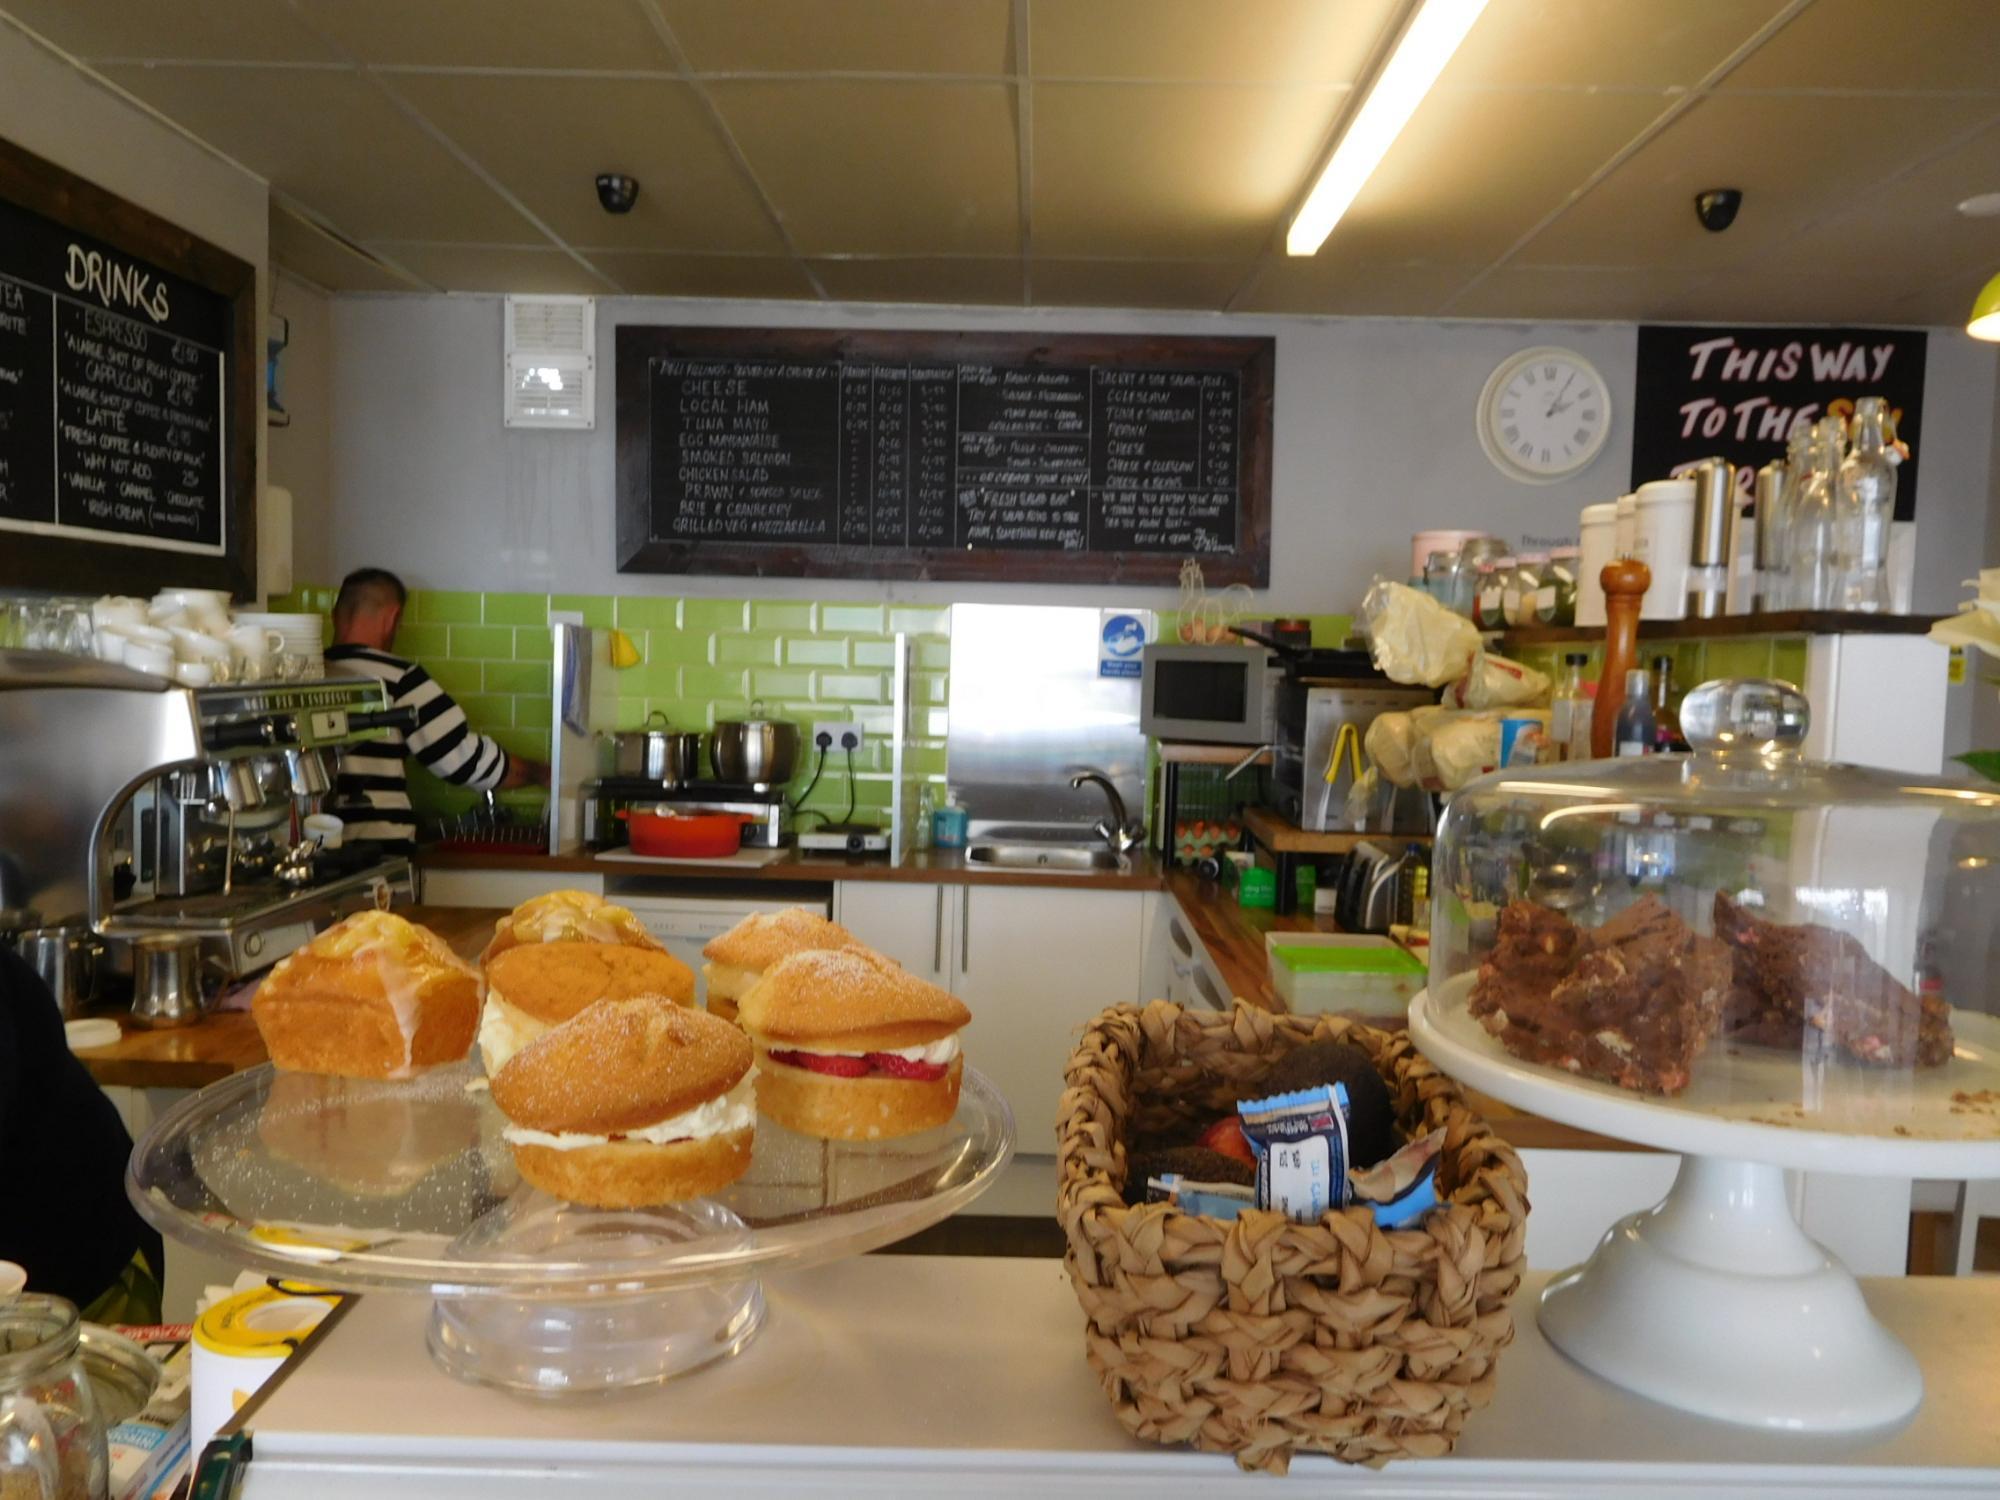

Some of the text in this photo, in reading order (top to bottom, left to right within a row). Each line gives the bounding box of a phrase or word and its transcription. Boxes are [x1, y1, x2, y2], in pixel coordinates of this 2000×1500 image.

[65, 244, 169, 323] DRINKS
[84, 309, 148, 351] ESPRESSO
[1689, 336, 1896, 383] THIS WAY
[84, 359, 153, 399] CAPPUCCINO
[681, 379, 748, 397] CHEESE
[1106, 387, 1171, 404] COLESLAW
[680, 398, 728, 415] LOCAL
[736, 398, 769, 415] HAM
[683, 416, 769, 432] TUNA MAYO
[1679, 397, 1728, 439] TO
[1732, 396, 1821, 442] THE
[678, 432, 704, 449] EGG
[682, 449, 735, 466] SMOKED
[742, 451, 792, 467] SALMON
[677, 465, 728, 482] CHICKEN
[730, 466, 769, 483] SALAD
[685, 482, 735, 500] PRAWN
[680, 499, 706, 517] BRIE
[726, 502, 793, 518] CRANBERRY
[672, 516, 723, 534] GRILLED
[724, 517, 748, 535] VEG
